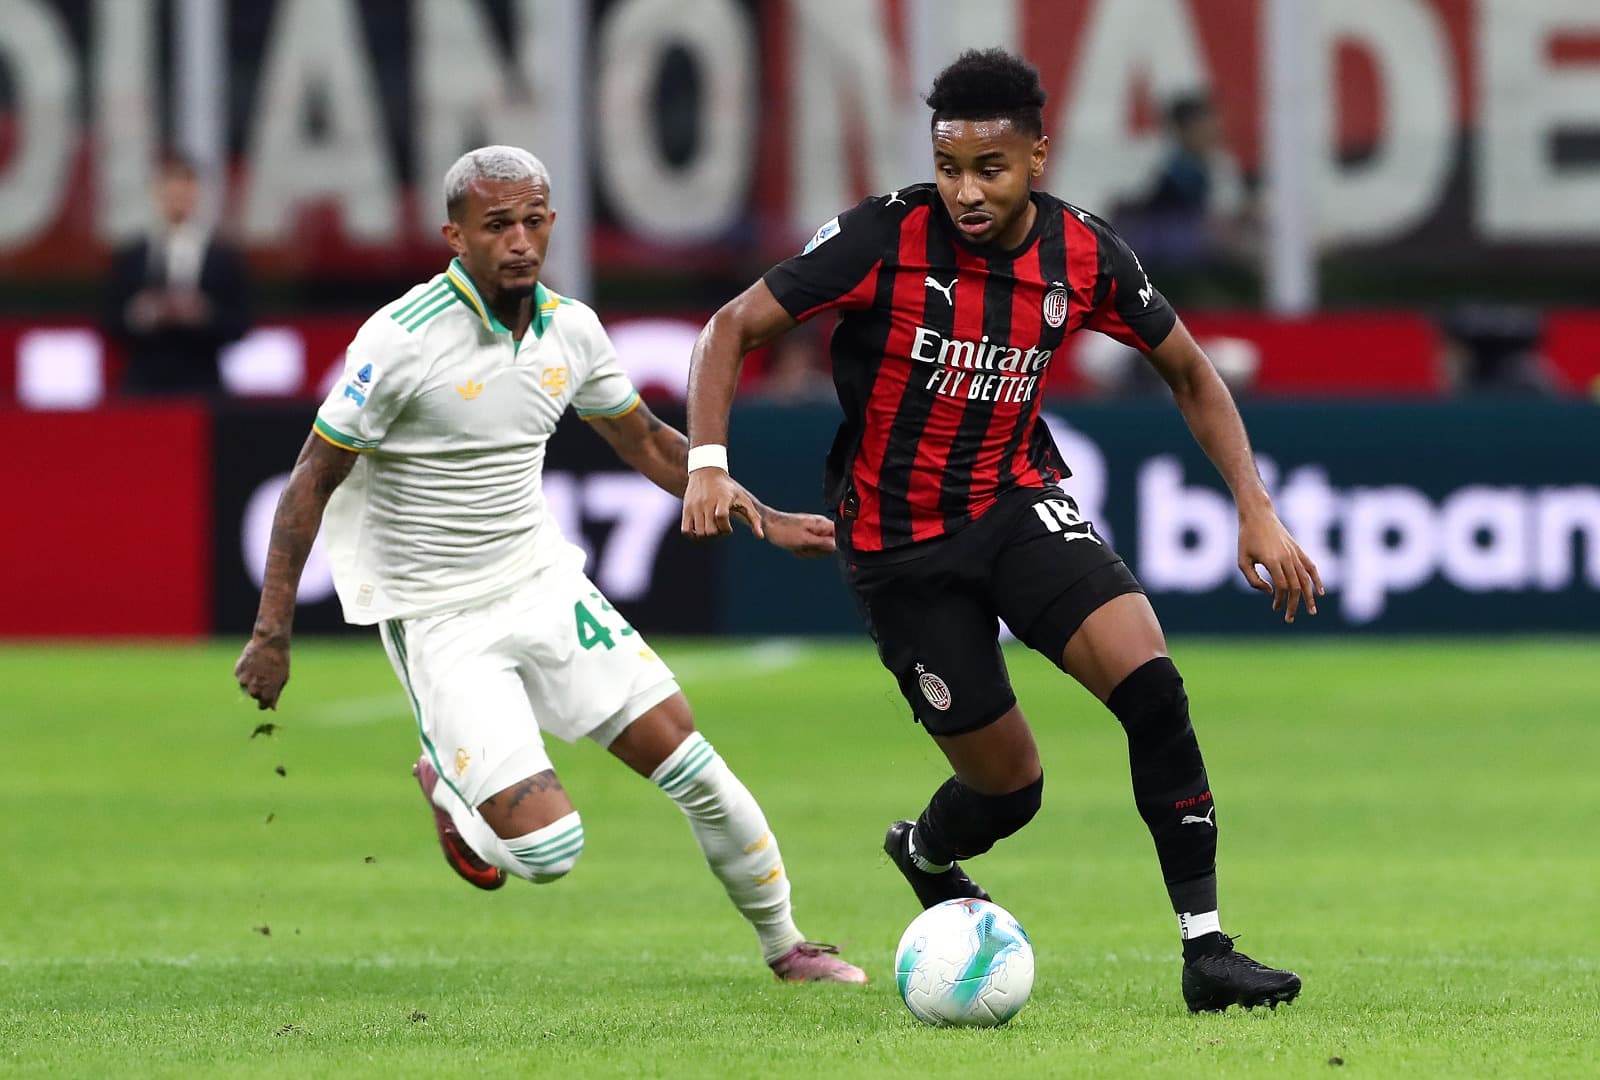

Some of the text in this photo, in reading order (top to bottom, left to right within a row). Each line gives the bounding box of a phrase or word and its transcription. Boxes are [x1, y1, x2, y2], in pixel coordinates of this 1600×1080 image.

[926, 368, 1037, 403] FLY BETTER
[1032, 499, 1081, 532] 18
